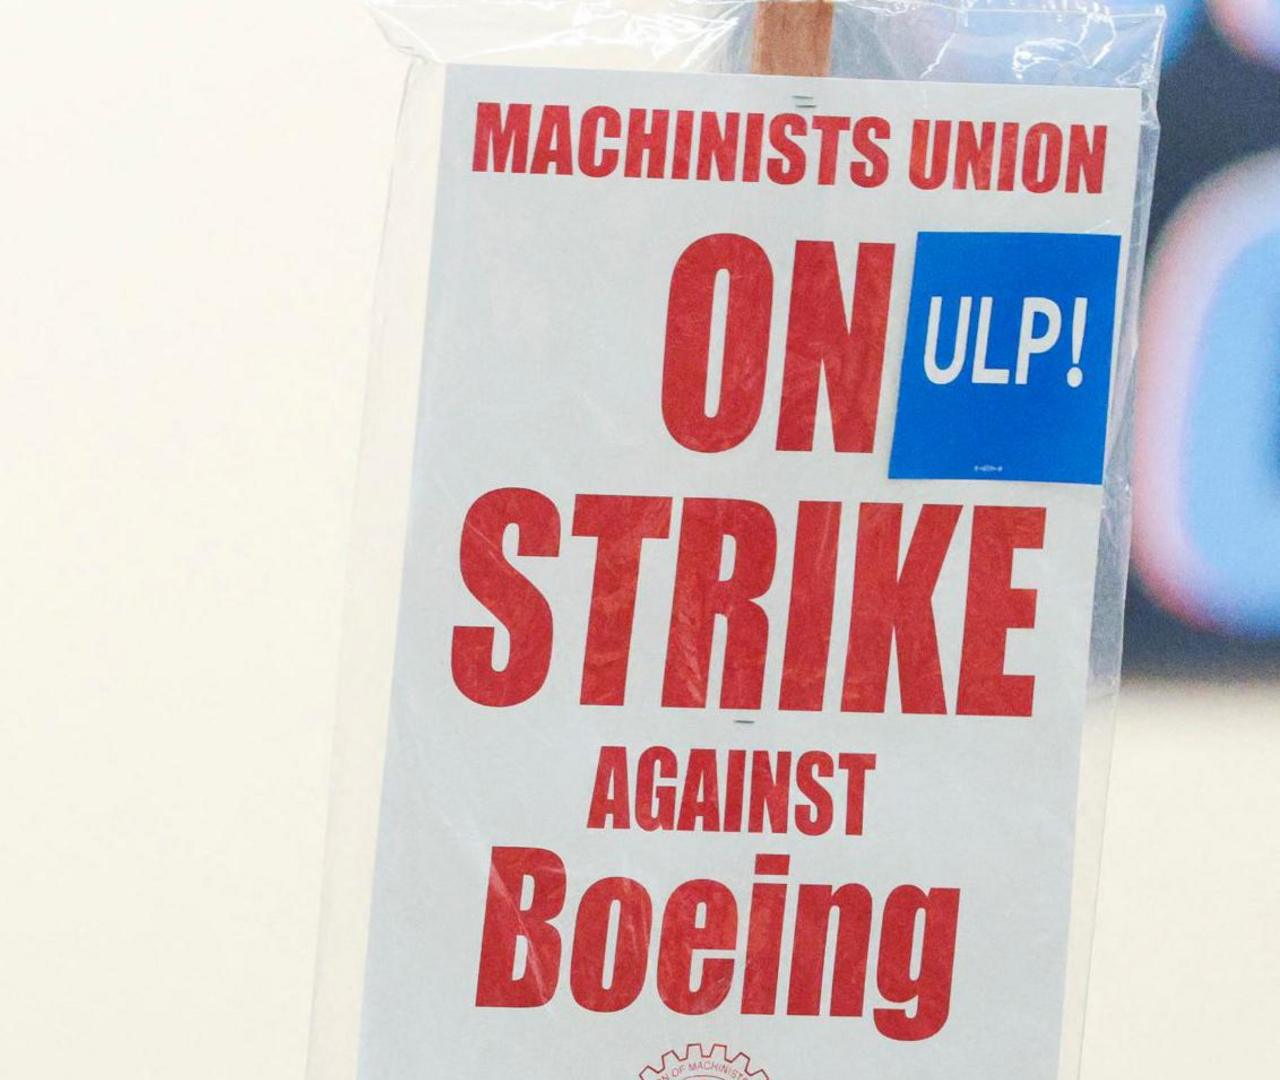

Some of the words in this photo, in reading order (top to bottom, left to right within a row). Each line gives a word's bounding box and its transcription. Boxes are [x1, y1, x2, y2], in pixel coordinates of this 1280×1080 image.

[472, 102, 891, 188] MACHINISTS
[908, 119, 1107, 195] UNION
[661, 233, 896, 454] ON
[923, 296, 1087, 389] ULP!
[451, 487, 1047, 718] STRIKE
[587, 745, 877, 836] AGAINST
[475, 846, 960, 1041] Boeing
